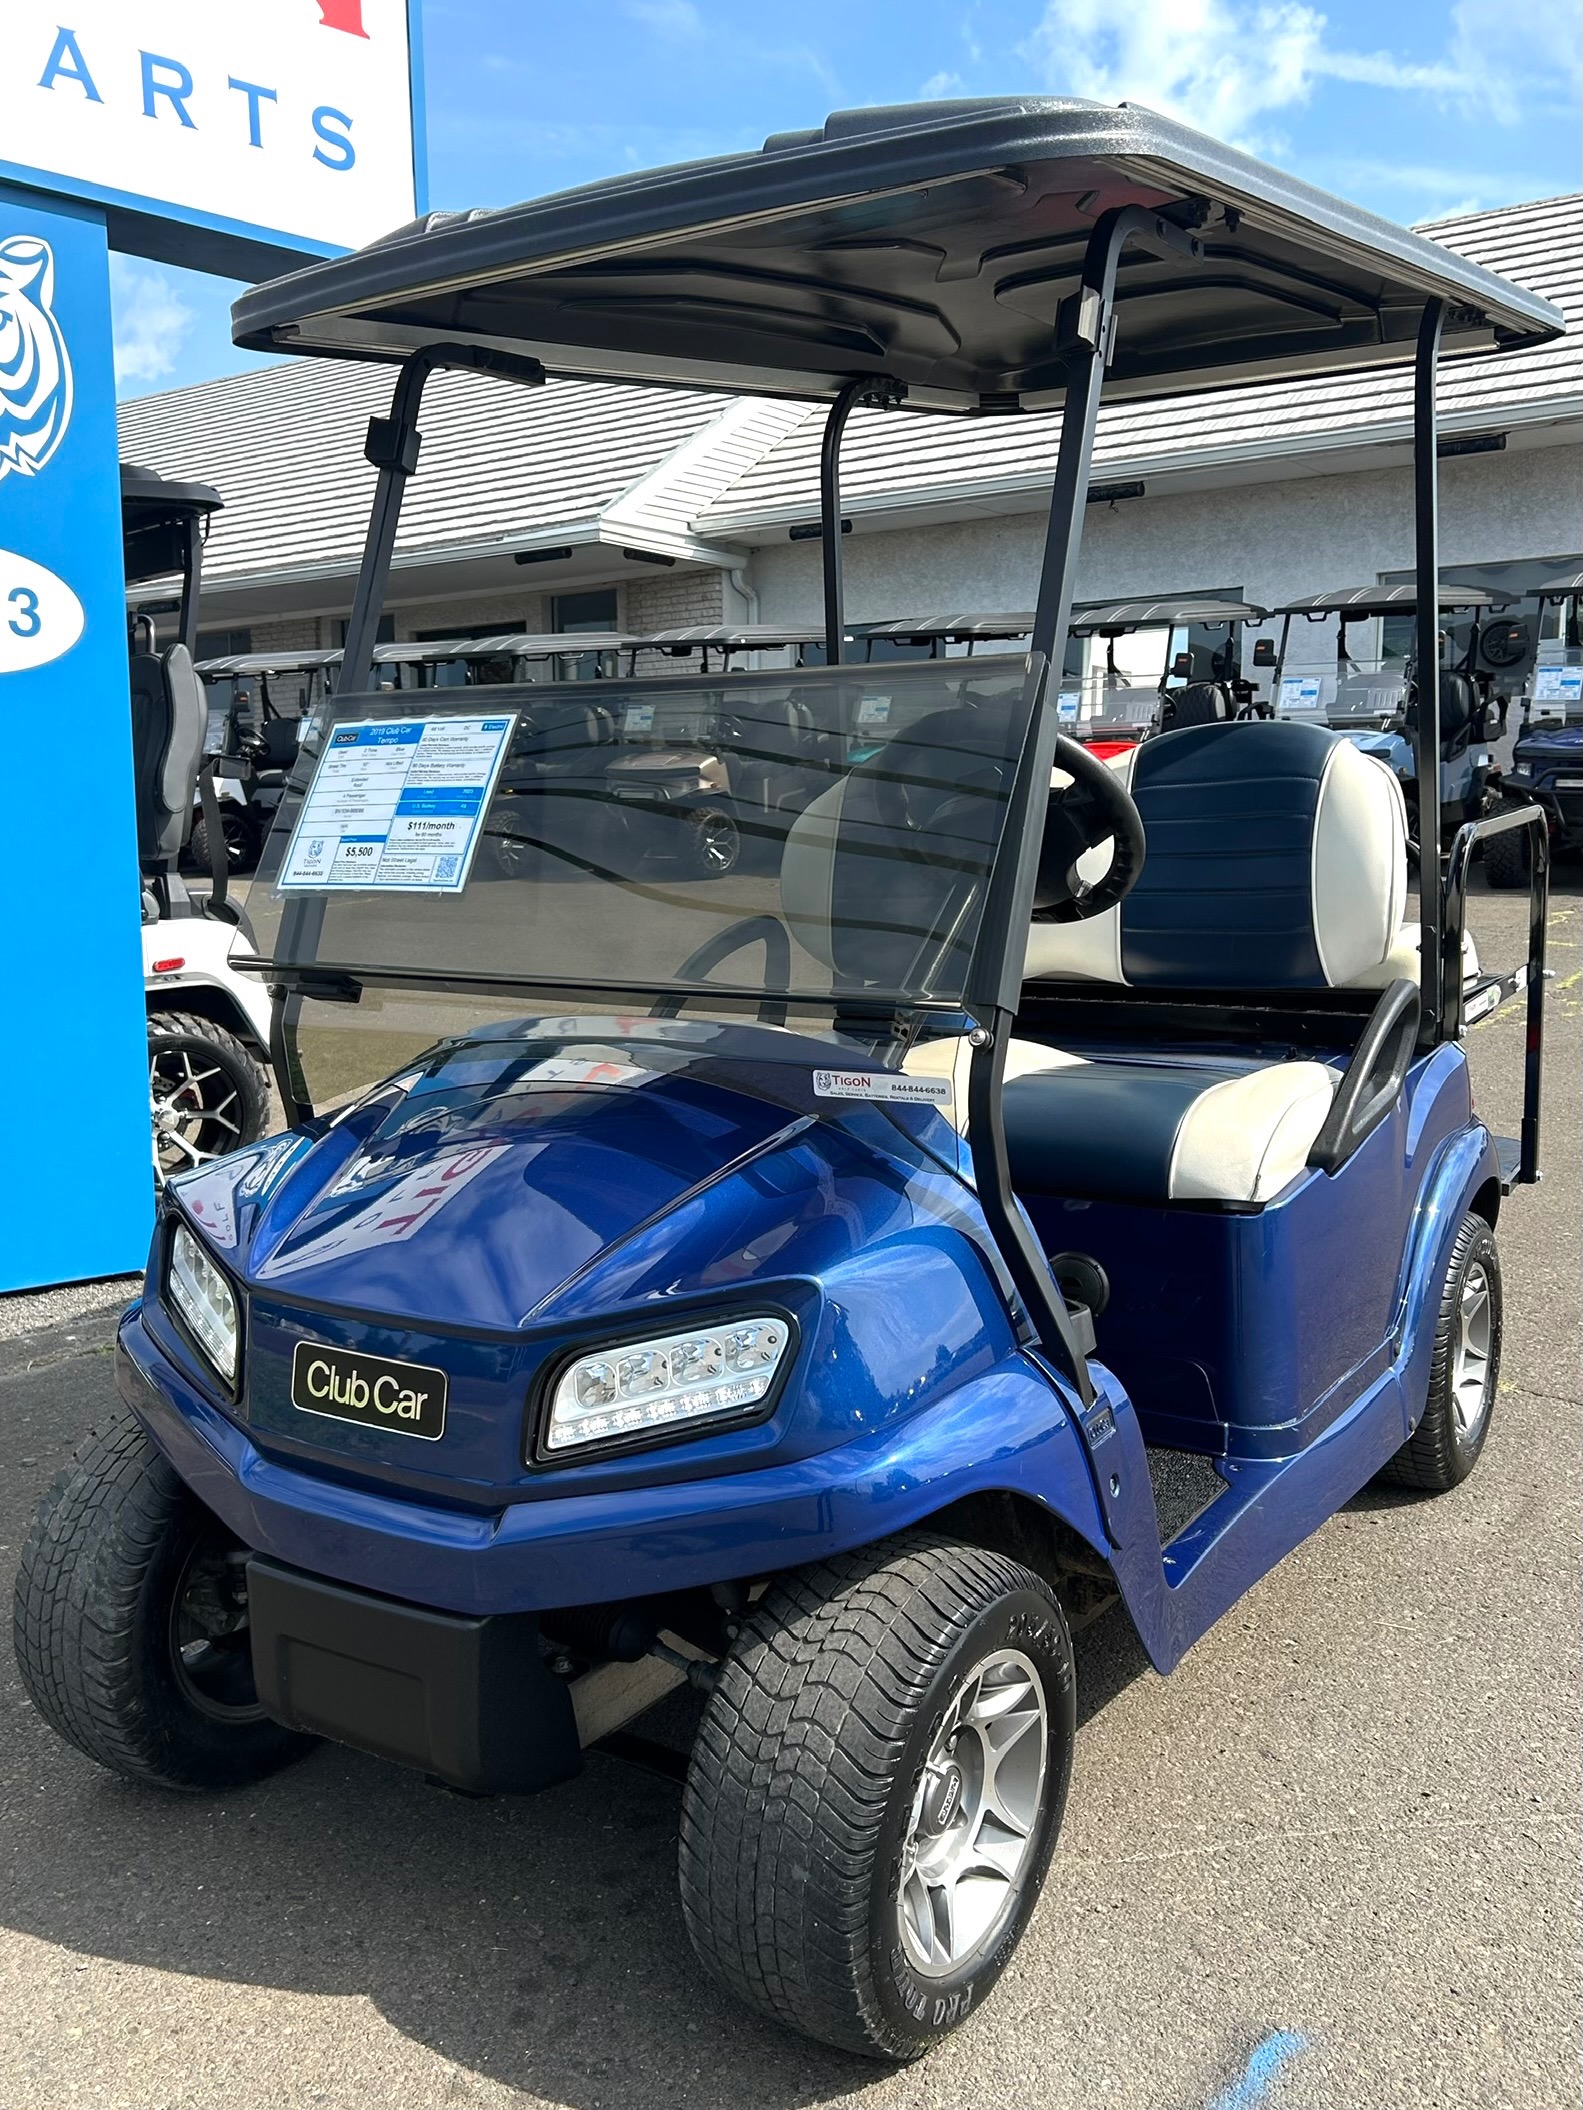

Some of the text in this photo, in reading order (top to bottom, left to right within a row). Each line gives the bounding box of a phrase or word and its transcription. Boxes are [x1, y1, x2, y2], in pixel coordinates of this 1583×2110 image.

[36, 25, 356, 171] ARTS
[8, 587, 42, 638] 3
[345, 846, 373, 857] $5,500
[407, 821, 455, 831] $111/month
[307, 1360, 429, 1420] Club Car
